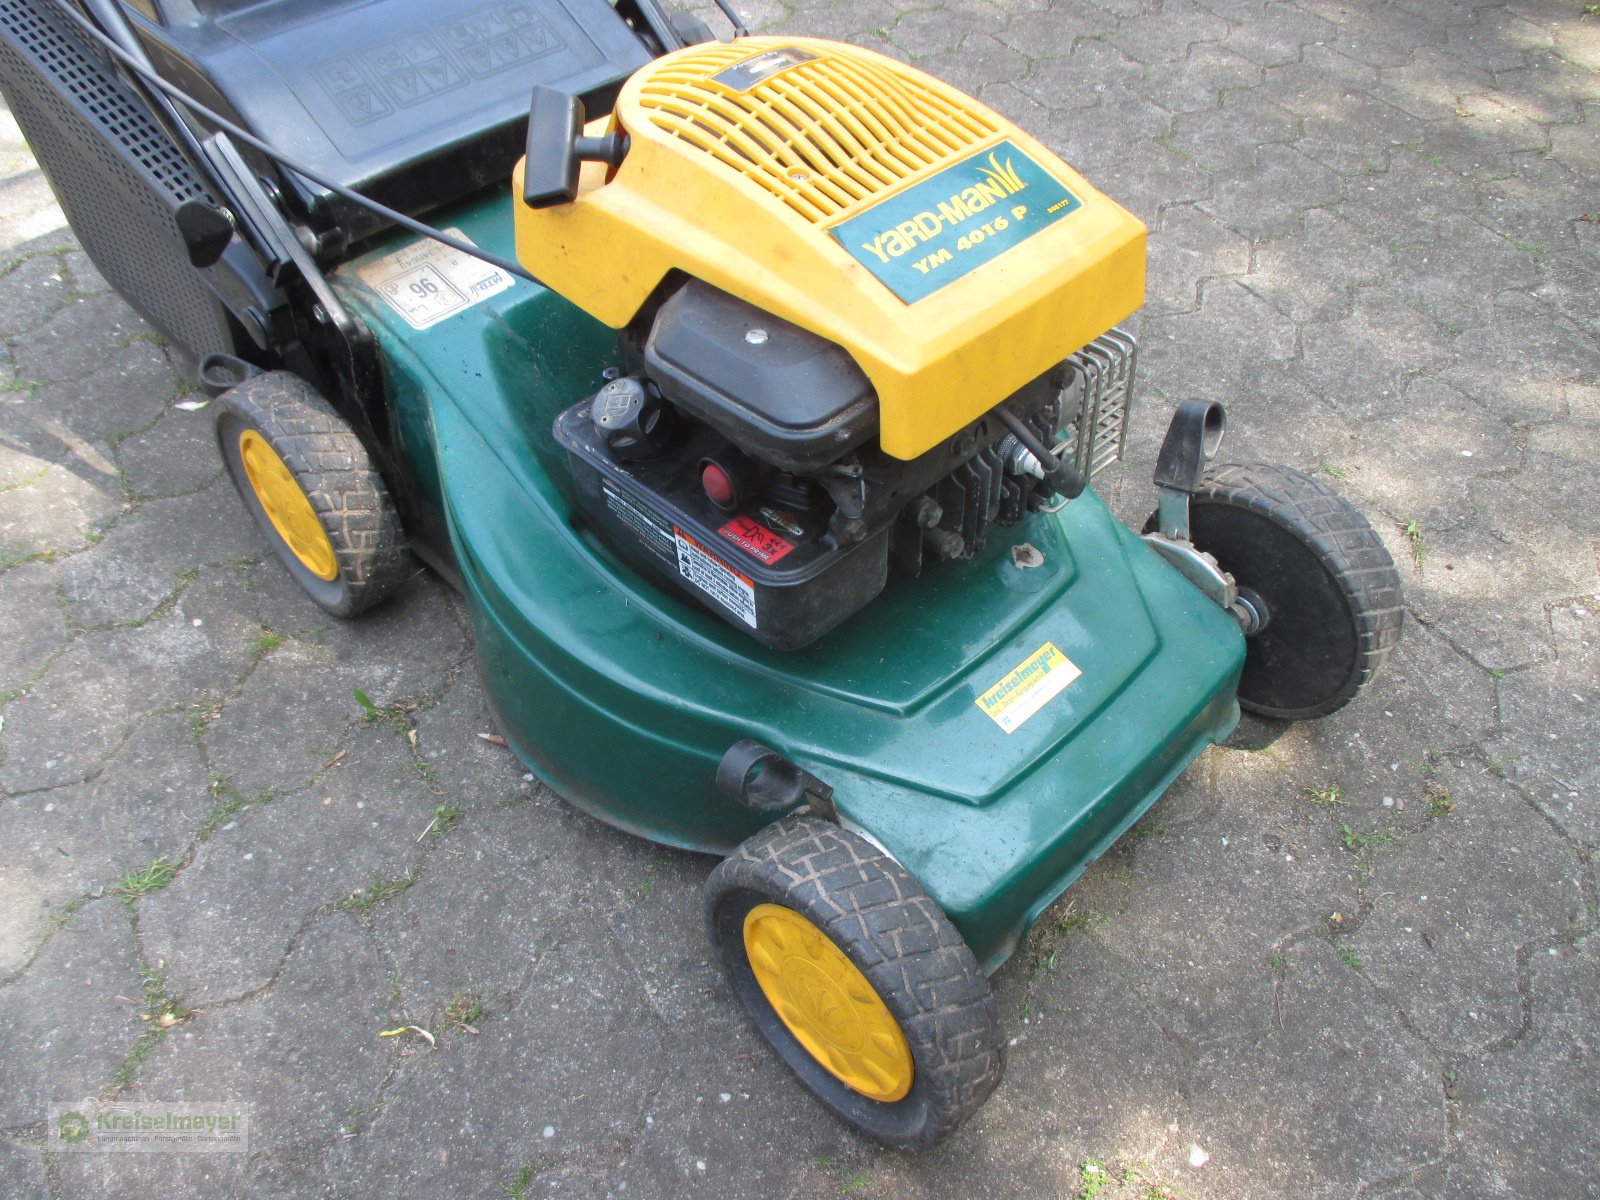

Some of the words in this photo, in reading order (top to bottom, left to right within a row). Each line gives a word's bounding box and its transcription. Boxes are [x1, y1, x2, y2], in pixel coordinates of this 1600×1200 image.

[912, 248, 954, 274] YM
[956, 215, 1009, 251] 4016
[1011, 205, 1029, 221] P
[408, 277, 439, 299] 96
[723, 529, 741, 542] PUSH
[750, 546, 771, 561] PRIME
